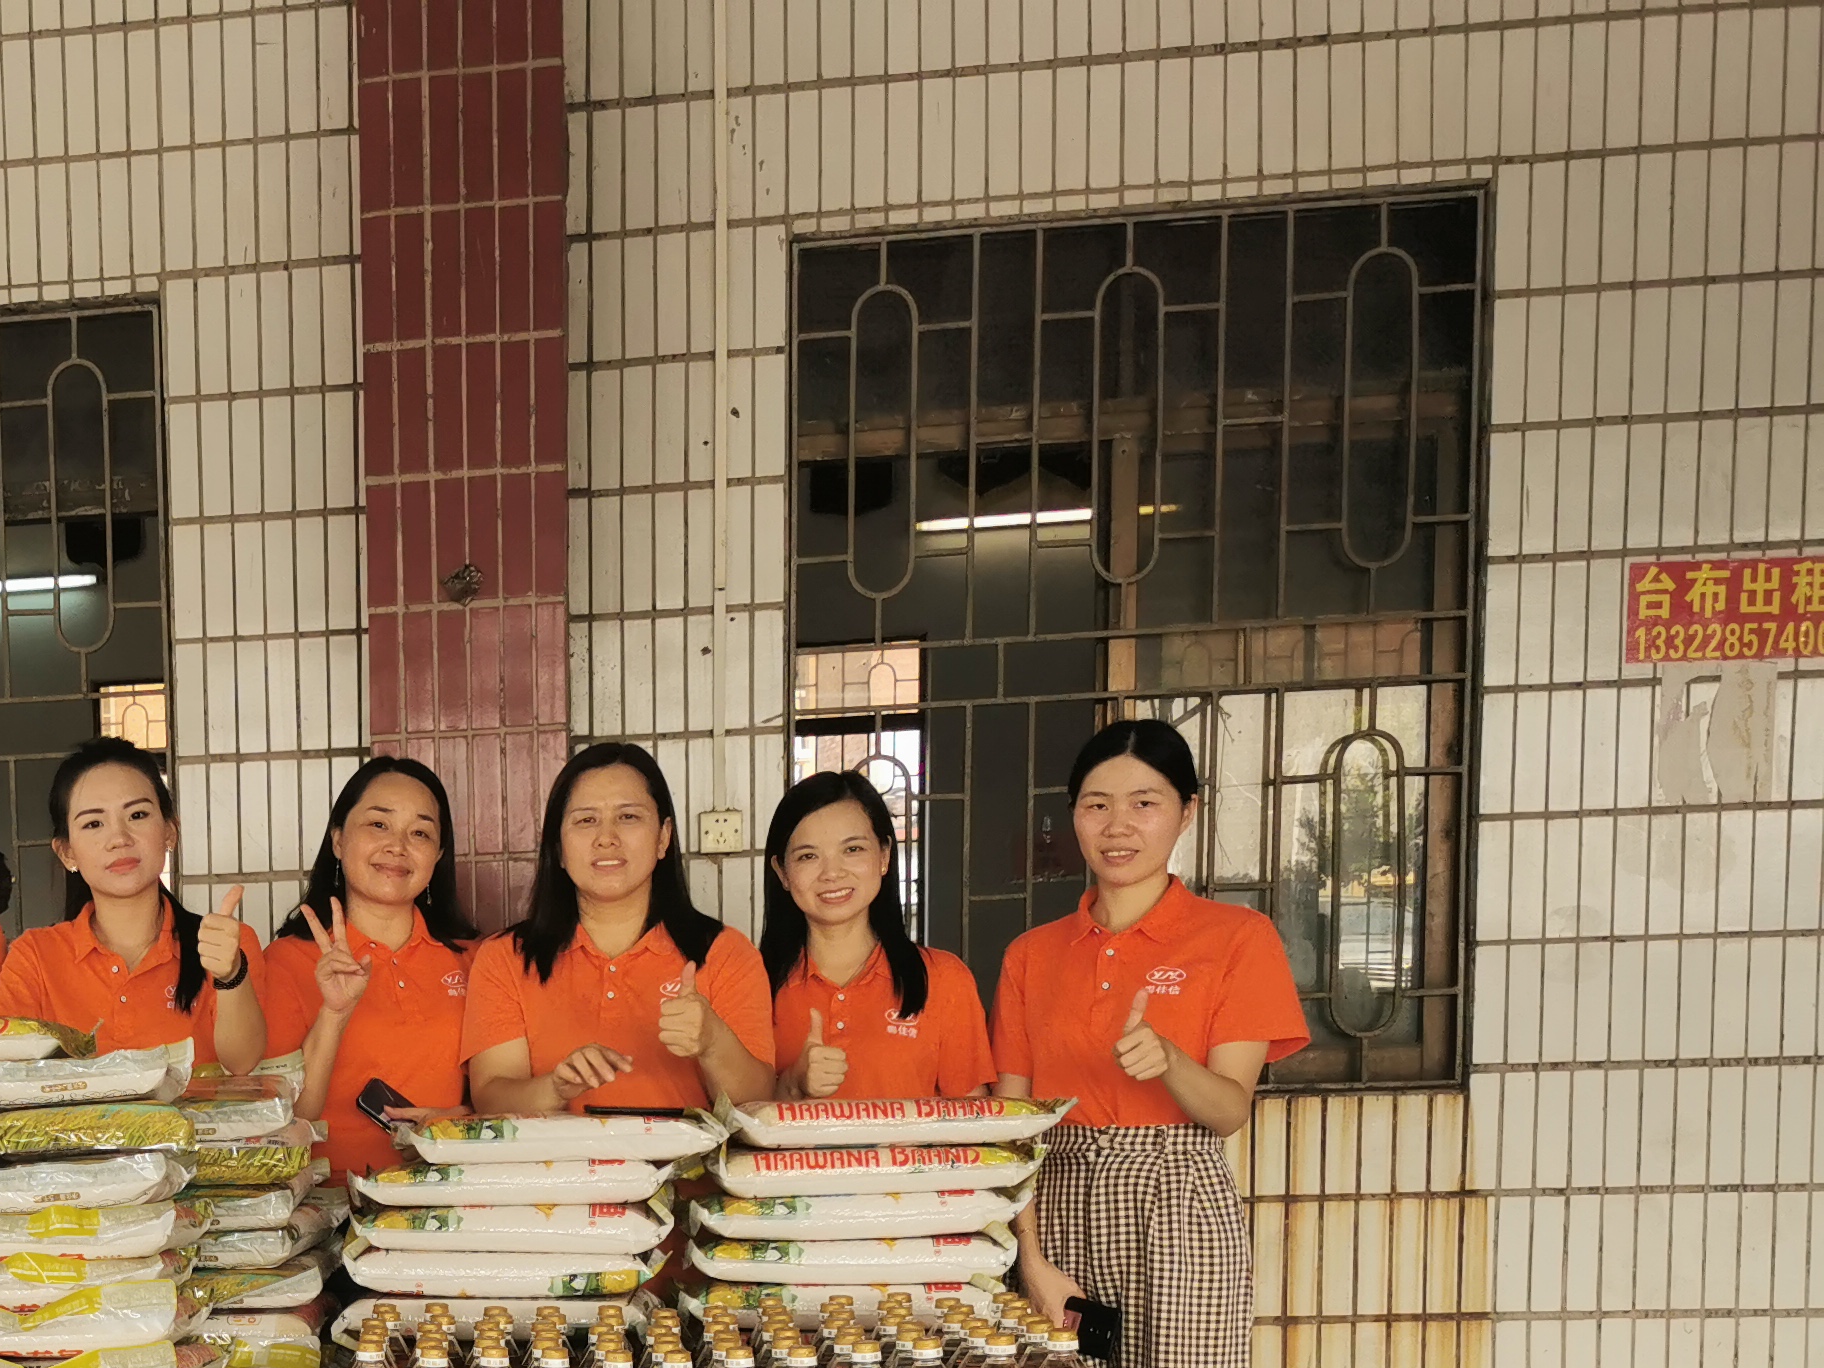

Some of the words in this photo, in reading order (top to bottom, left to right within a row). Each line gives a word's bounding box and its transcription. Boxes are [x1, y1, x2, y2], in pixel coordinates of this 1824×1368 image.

[1635, 560, 1824, 620] 台布出租
[776, 1101, 905, 1122] ARAWANA
[915, 1099, 1005, 1118] BRAND
[753, 1149, 880, 1172] ARAWANA
[890, 1146, 980, 1167] BRAND
